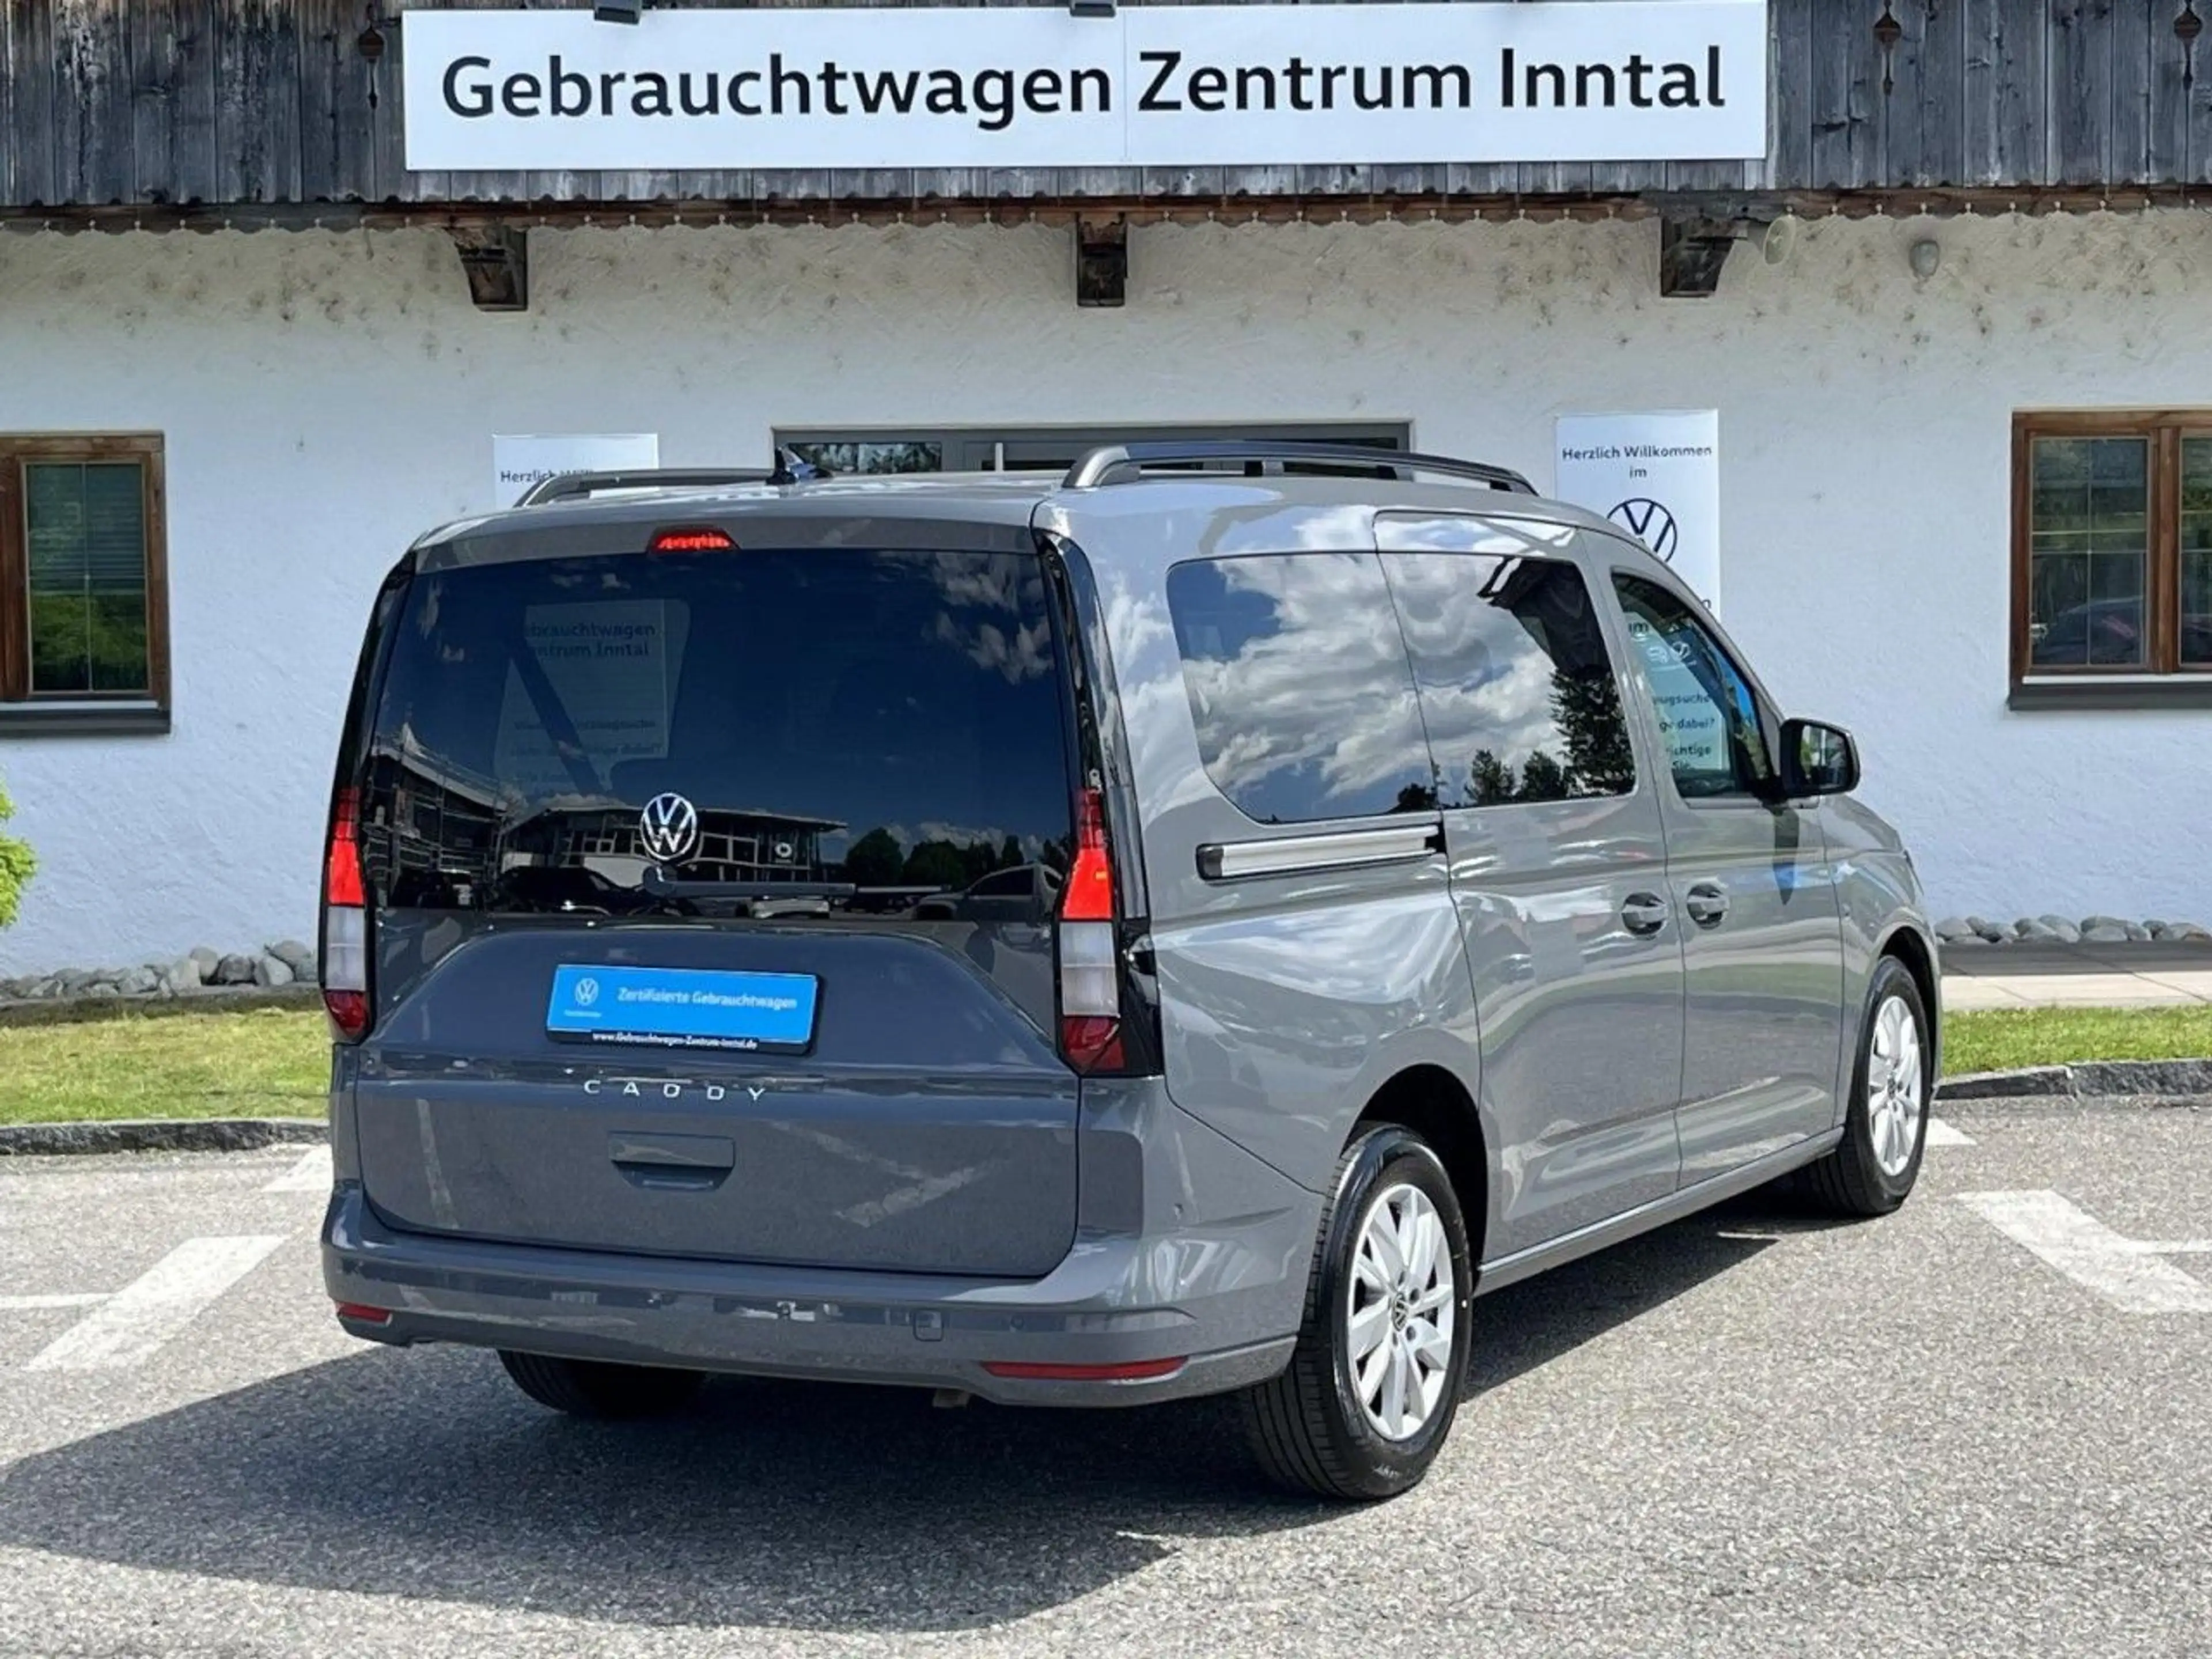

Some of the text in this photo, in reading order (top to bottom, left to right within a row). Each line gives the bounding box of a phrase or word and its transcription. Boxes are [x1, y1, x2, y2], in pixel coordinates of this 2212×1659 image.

[442, 45, 1726, 130] Gebrauchtwagen Zentrum Inntal
[1562, 445, 1712, 460] Herzlich Willkommen
[1629, 466, 1647, 479] im
[692, 990, 799, 1011] Gebrauchtwagen
[583, 1080, 766, 1101] CADDY
